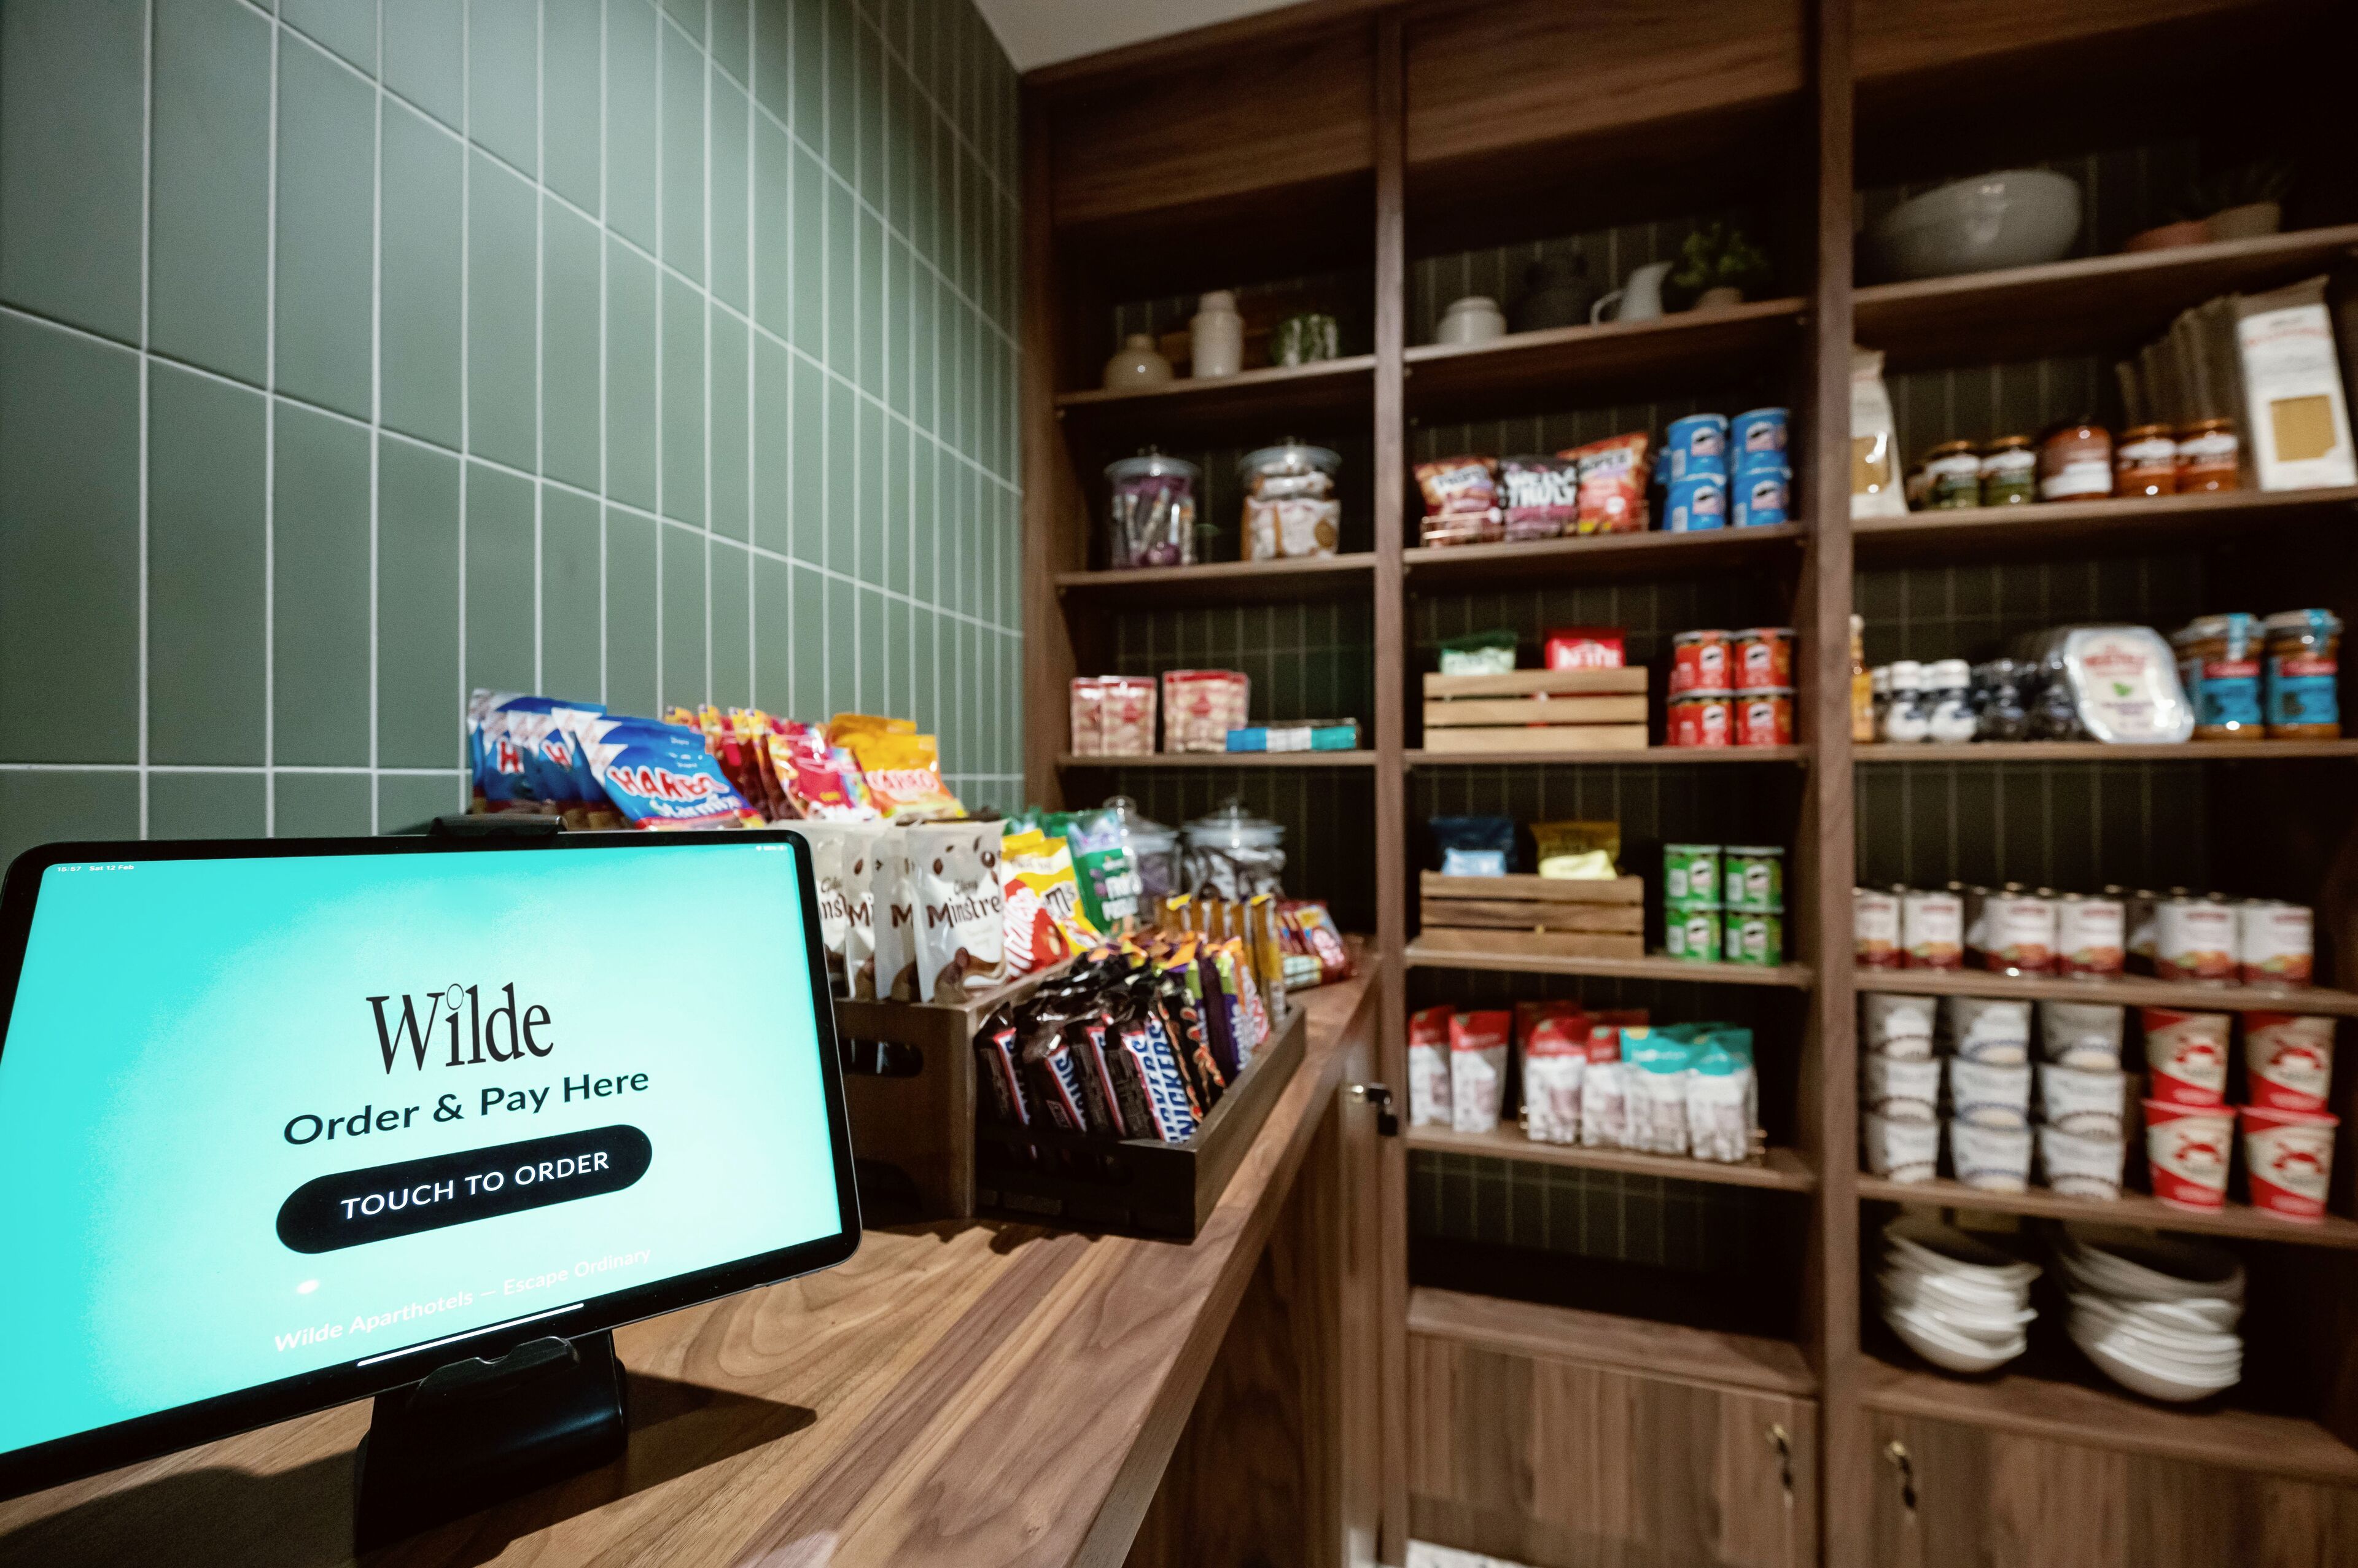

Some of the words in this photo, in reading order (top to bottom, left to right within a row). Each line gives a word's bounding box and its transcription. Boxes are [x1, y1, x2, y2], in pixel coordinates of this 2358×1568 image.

[927, 896, 1001, 929] Minstre
[365, 981, 554, 1075] Wilde
[284, 1104, 420, 1145] Order
[433, 1093, 465, 1122] &
[481, 1085, 550, 1116] Pay
[562, 1073, 650, 1103] Here
[1152, 1022, 1196, 1137] NICKERS
[341, 1179, 454, 1219] TOUCH
[464, 1171, 505, 1195] TO
[515, 1151, 610, 1185] ORDER
[274, 1321, 343, 1352] Wilde
[348, 1290, 474, 1335] Aparthotels
[504, 1268, 569, 1296] Escape
[574, 1249, 652, 1277] Ordinary
